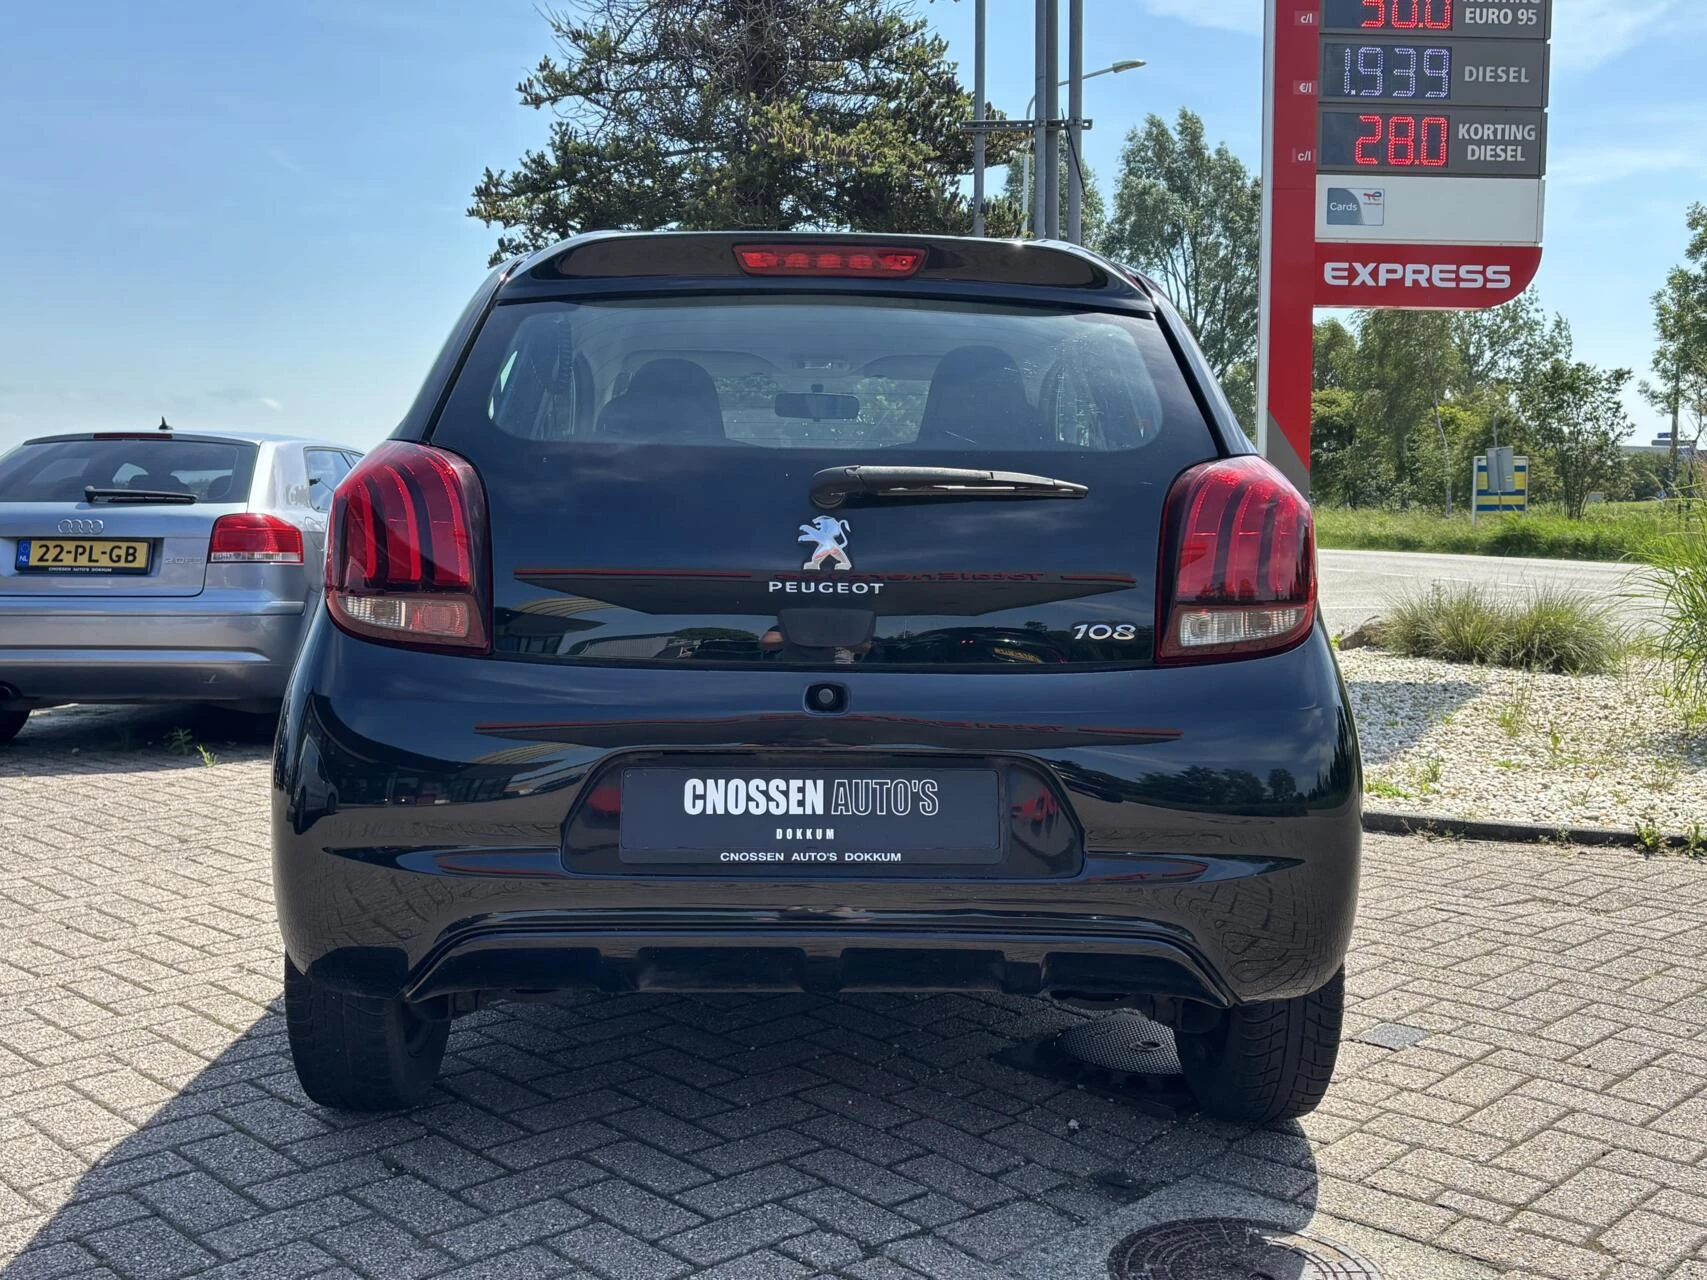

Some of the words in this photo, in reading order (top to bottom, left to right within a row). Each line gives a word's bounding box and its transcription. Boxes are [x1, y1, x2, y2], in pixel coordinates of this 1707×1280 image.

[1300, 12, 1313, 24] c/l
[1464, 7, 1512, 25] EURO
[1517, 9, 1538, 26] 95
[1343, 47, 1450, 98] 1.939
[1464, 66, 1530, 83] DIESEL
[1299, 82, 1312, 94] €/l
[1355, 114, 1449, 166] 28.0
[1458, 123, 1536, 141] KORTING
[1297, 151, 1311, 162] c/l
[1467, 145, 1526, 162] DIESEL
[1330, 202, 1358, 212] Cards
[1323, 262, 1512, 289] EXPRESS
[36, 543, 138, 564] 22-PL-GB
[768, 581, 884, 594] PEUGEOT
[1073, 623, 1137, 640] 108
[684, 778, 824, 815] CNOSSEN
[831, 779, 939, 816] AUTO'S
[776, 828, 835, 840] DOKKUM
[720, 852, 784, 862] CNOSSEN
[791, 852, 838, 862] AUTO'S
[844, 852, 902, 862] DOKKUM
